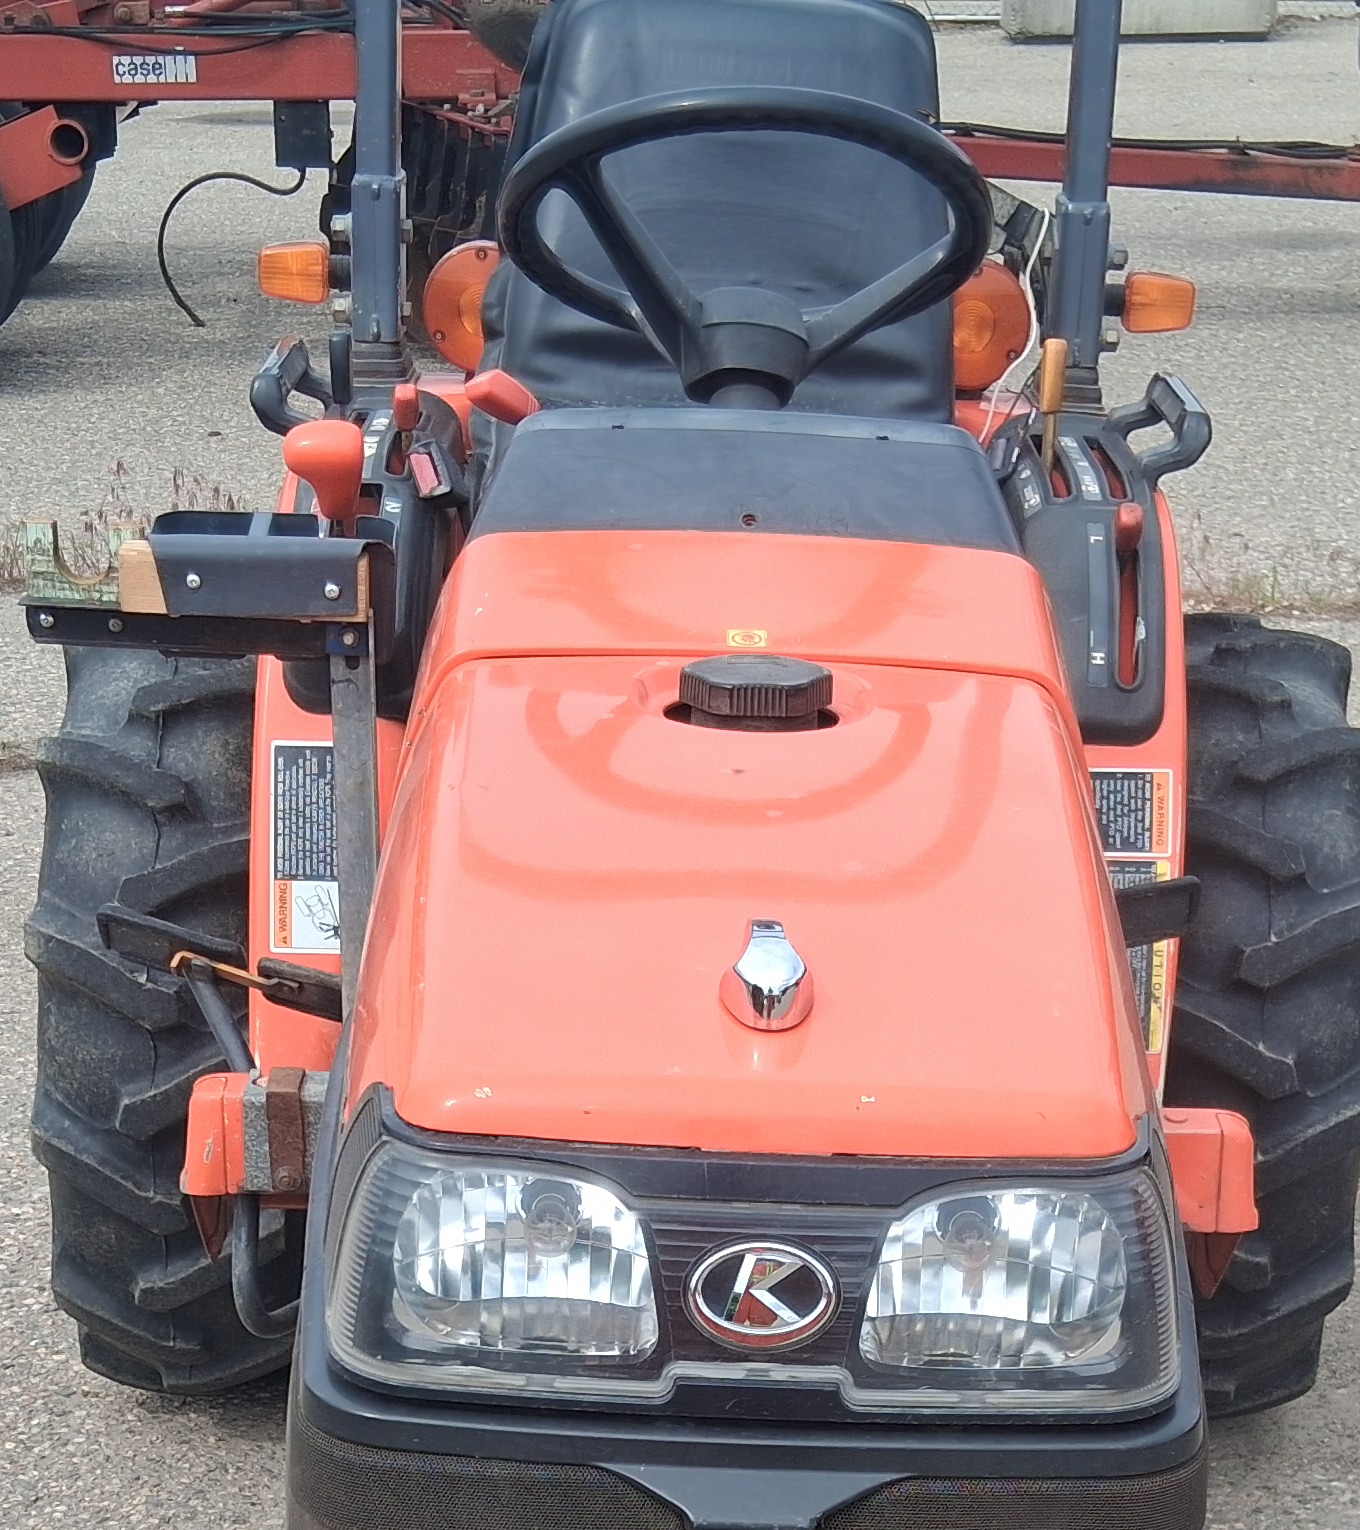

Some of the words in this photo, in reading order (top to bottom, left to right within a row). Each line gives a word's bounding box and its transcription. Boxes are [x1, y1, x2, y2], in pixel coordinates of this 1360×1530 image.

[1089, 535, 1104, 544] L
[1090, 652, 1106, 665] H
[1156, 795, 1165, 847] WARNING
[278, 882, 288, 932] WARNING
[722, 1253, 805, 1325] K
